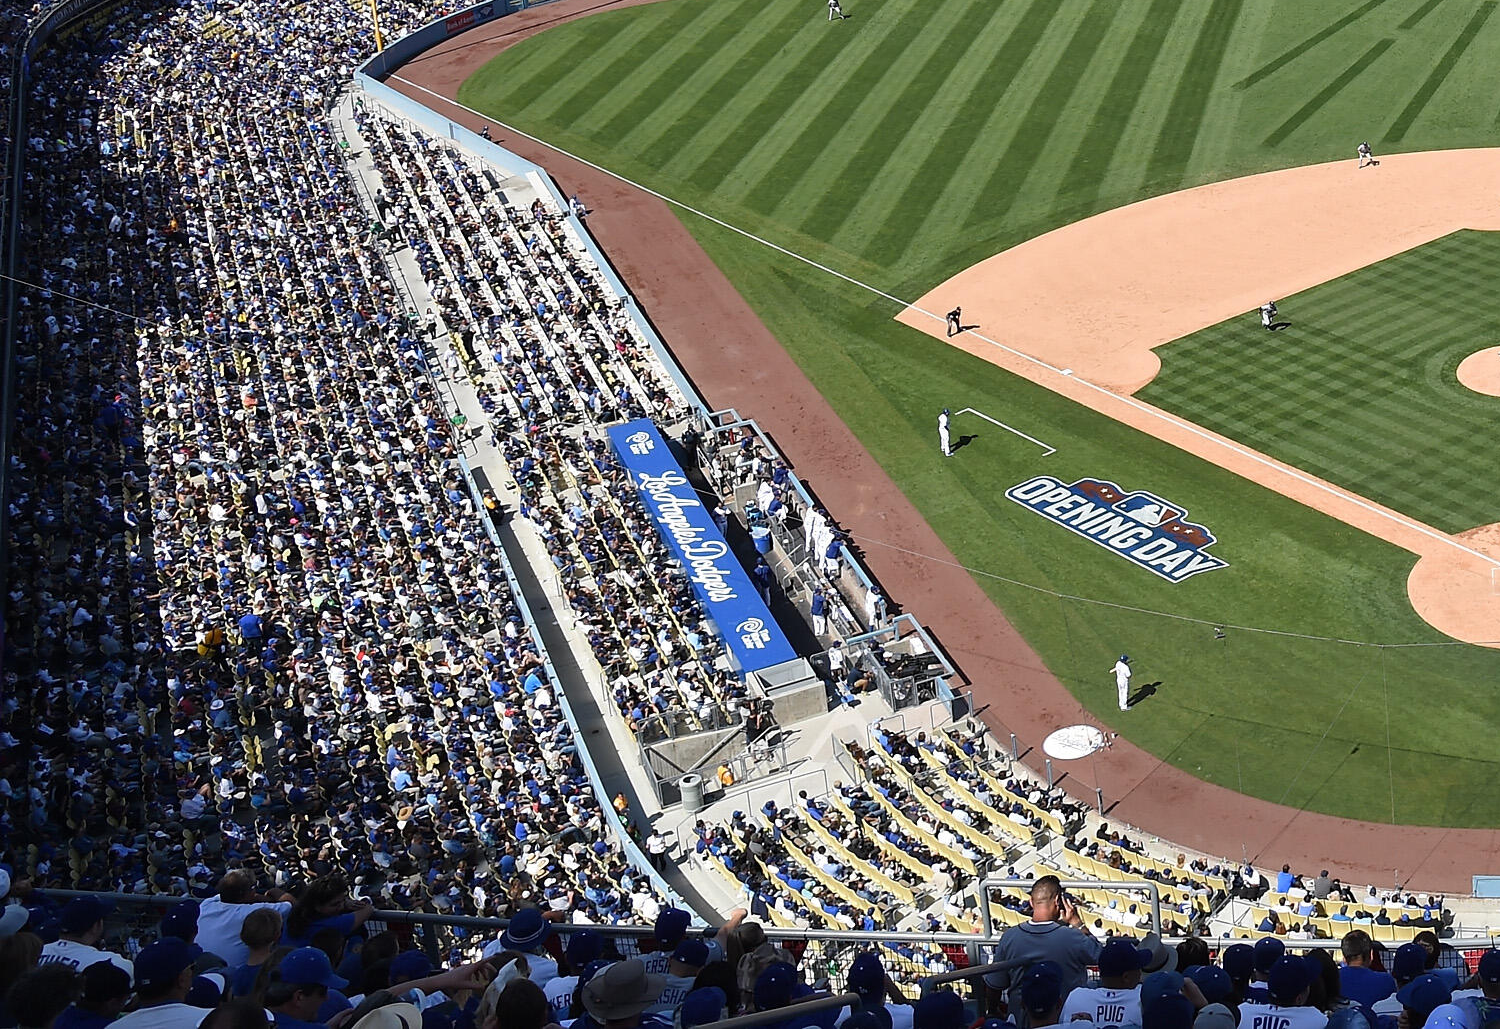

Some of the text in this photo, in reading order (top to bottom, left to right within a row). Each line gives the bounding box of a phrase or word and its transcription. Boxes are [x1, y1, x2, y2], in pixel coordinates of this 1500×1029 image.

[638, 470, 737, 602] Los Angeles Dodgers
[1012, 478, 1217, 578] OPENING DAY
[1096, 1005, 1125, 1023] PUIG
